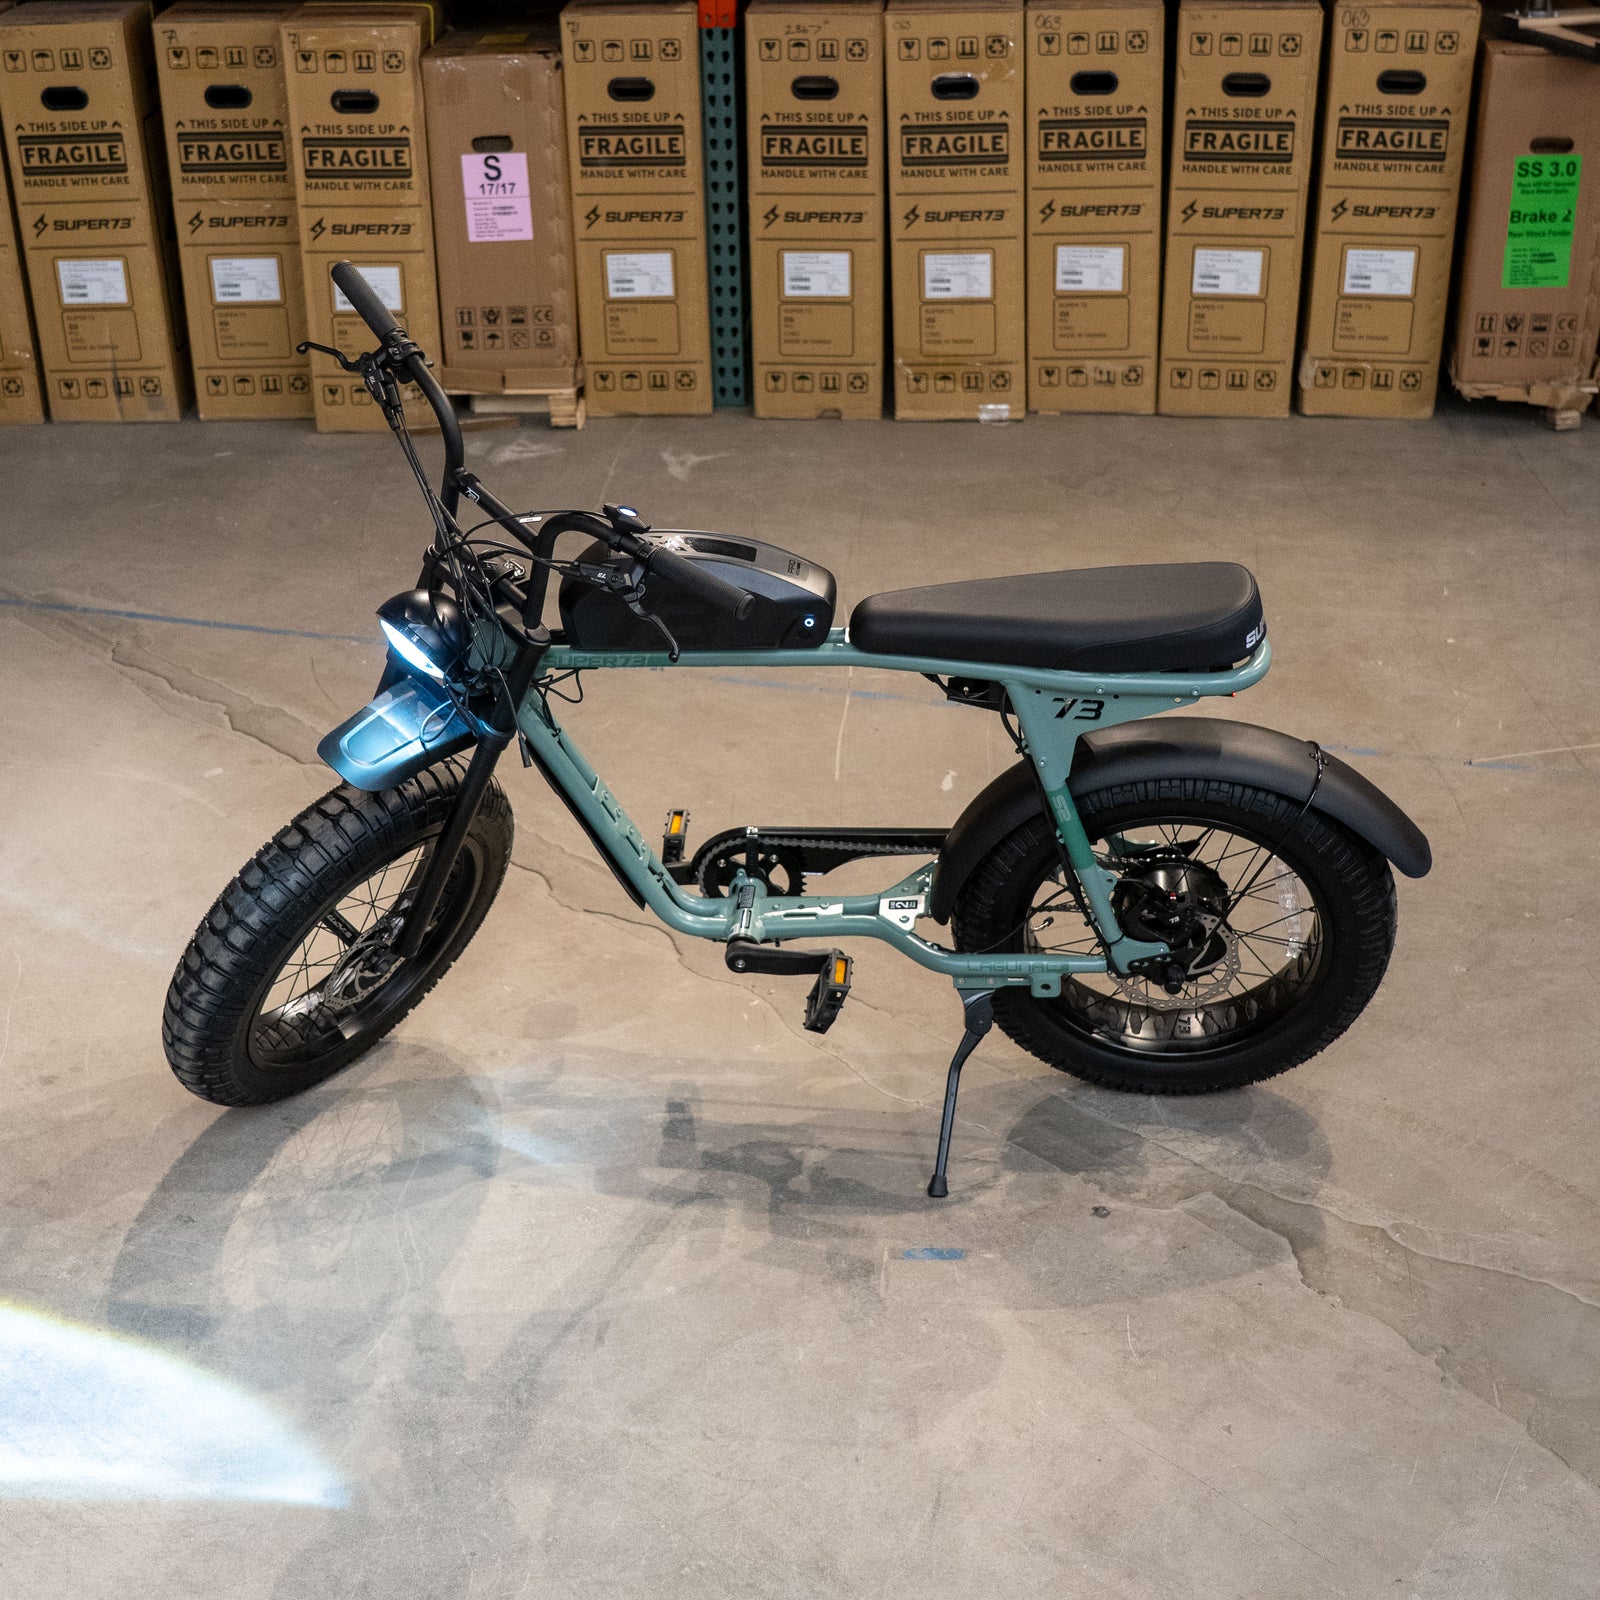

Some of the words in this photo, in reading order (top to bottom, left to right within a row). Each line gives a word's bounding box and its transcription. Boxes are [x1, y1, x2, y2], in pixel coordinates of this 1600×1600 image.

[914, 111, 942, 122] THIS
[946, 111, 974, 121] SIDE
[977, 110, 995, 120] UP
[1053, 106, 1081, 116] THIS
[1084, 106, 1113, 116] SIDE
[1116, 105, 1133, 115] UP
[1201, 107, 1229, 117] THIS
[1232, 108, 1262, 118] SIDE
[1265, 109, 1282, 118] UP
[1355, 104, 1383, 115] THIS
[1387, 105, 1415, 116] SIDE
[1419, 106, 1437, 116] UP
[592, 113, 618, 123] THIS
[623, 113, 650, 122] SIDE
[654, 112, 670, 122] UP
[774, 112, 802, 122] THIS
[806, 113, 834, 122] SIDE
[837, 113, 854, 123] UP
[29, 122, 56, 132] THIS
[60, 121, 88, 131] SIDE
[91, 121, 107, 130] UP
[190, 119, 217, 129] THIS
[221, 120, 249, 129] SIDE
[253, 119, 268, 128] UP
[315, 125, 343, 135] THIS
[346, 125, 375, 134] SIDE
[379, 125, 395, 134] UP
[905, 135, 1004, 154] FRAGILE
[1043, 130, 1141, 149] FRAGILE
[1189, 132, 1289, 151] FRAGILE
[1341, 129, 1442, 150] FRAGILE
[183, 143, 280, 161] FRAGILE
[584, 137, 680, 155] FRAGILE
[766, 137, 863, 155] FRAGILE
[24, 145, 121, 164] FRAGILE
[308, 149, 406, 167] FRAGILE
[484, 155, 502, 181] S
[581, 170, 624, 178] HANDLE
[627, 170, 655, 178] WITH
[658, 169, 687, 178] CARE
[901, 169, 945, 178] HANDLE
[948, 168, 977, 177] WITH
[980, 167, 1009, 177] CARE
[1038, 164, 1083, 173] HANDLE
[1085, 163, 1114, 172] WITH
[1117, 162, 1147, 171] CARE
[1182, 164, 1228, 174] HANDLE
[1231, 165, 1259, 174] WITH
[1263, 166, 1292, 175] CARE
[1334, 162, 1380, 172] HANDLE
[1383, 163, 1412, 173] WITH
[1415, 164, 1445, 174] CARE
[1517, 161, 1543, 177] SS
[1549, 161, 1577, 177] 3.0
[182, 175, 225, 184] HANDLE
[229, 175, 256, 183] WITH
[260, 174, 288, 183] CARE
[761, 170, 805, 178] HANDLE
[808, 170, 836, 178] WITH
[839, 170, 868, 178] CARE
[24, 178, 67, 188] HANDLE
[71, 177, 98, 186] WITH
[102, 176, 130, 185] CARE
[305, 182, 350, 190] HANDLE
[353, 182, 380, 190] WITH
[384, 181, 413, 190] CARE
[480, 182, 516, 195] 17/17
[605, 211, 684, 222] SUPER73
[924, 209, 1005, 222] SUPER73
[1060, 204, 1141, 217] SUPER73
[1202, 207, 1284, 220] SUPER73
[1352, 205, 1436, 219] SUPER73
[1510, 209, 1557, 223] Brake
[1562, 209, 1572, 222] 2
[208, 215, 288, 228] SUPER73
[783, 211, 863, 223] SUPER73
[53, 217, 131, 231] SUPER73
[331, 224, 412, 235] SUPER73
[543, 655, 649, 668] SUPER73
[1052, 697, 1105, 721] 73
